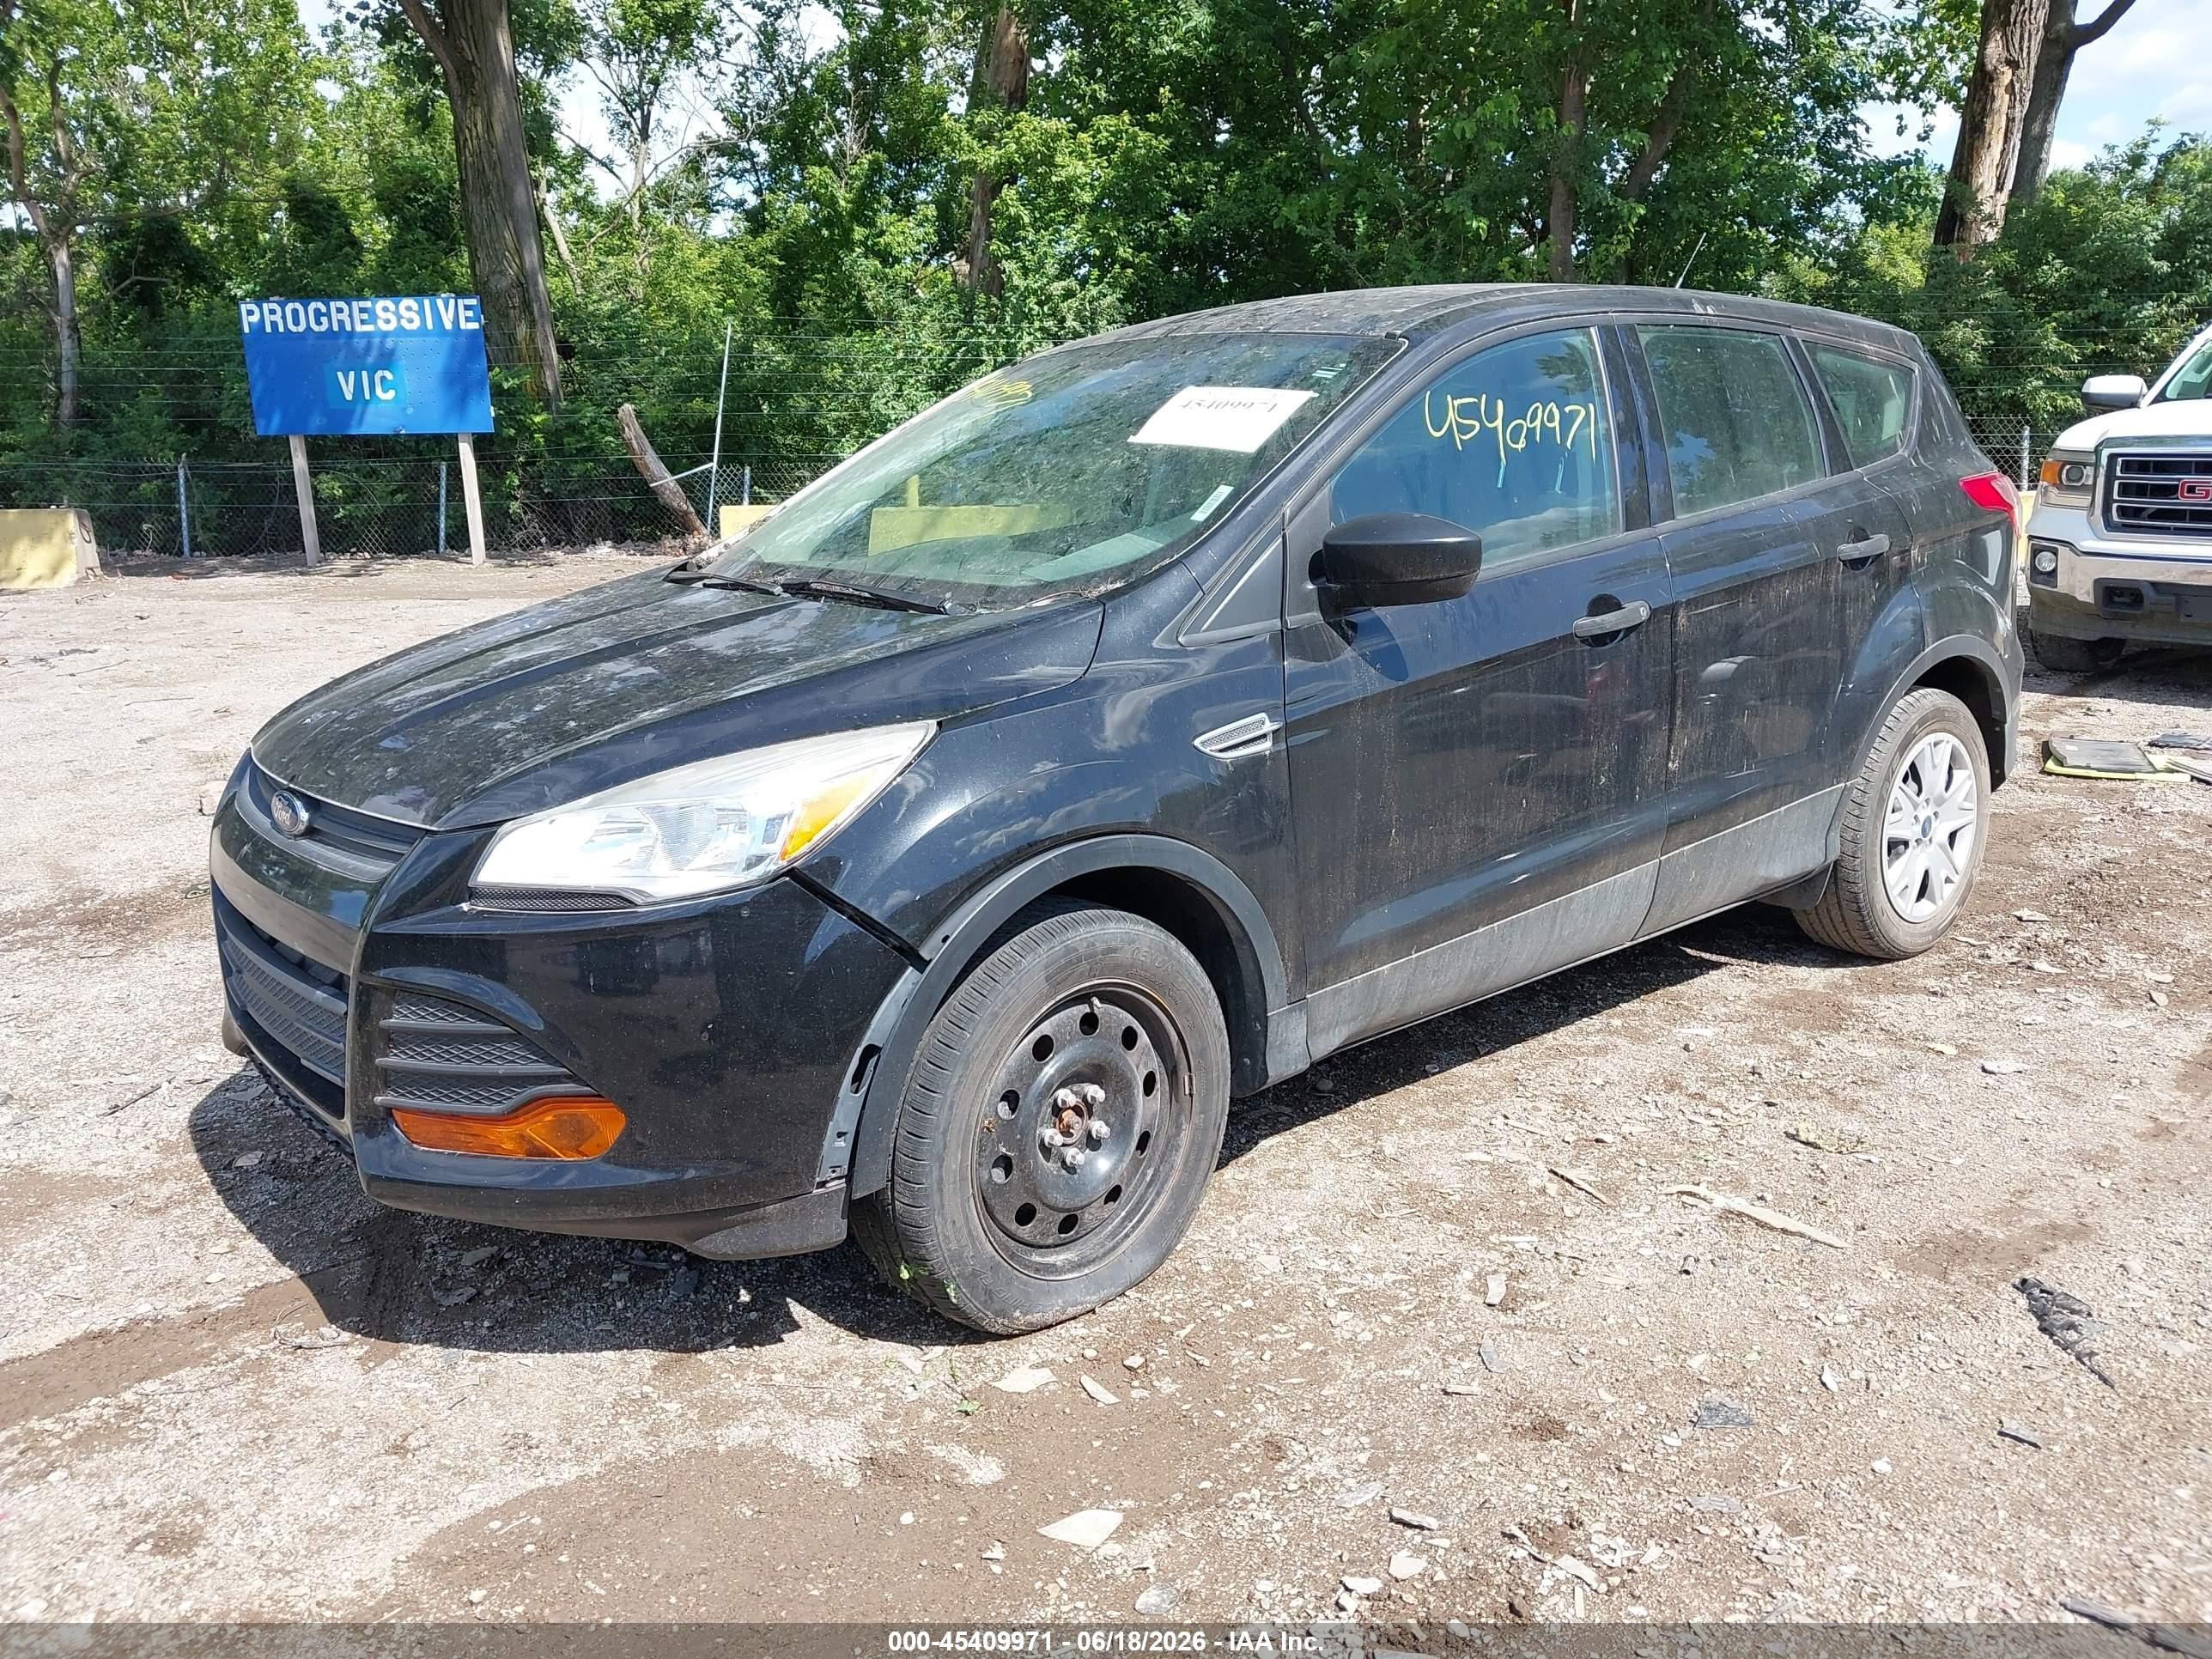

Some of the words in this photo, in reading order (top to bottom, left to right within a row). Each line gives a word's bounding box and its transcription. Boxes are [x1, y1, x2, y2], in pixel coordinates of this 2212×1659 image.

[240, 298, 480, 334] PROGRESSIVE
[337, 370, 396, 401] VIC
[274, 795, 292, 825] Ford
